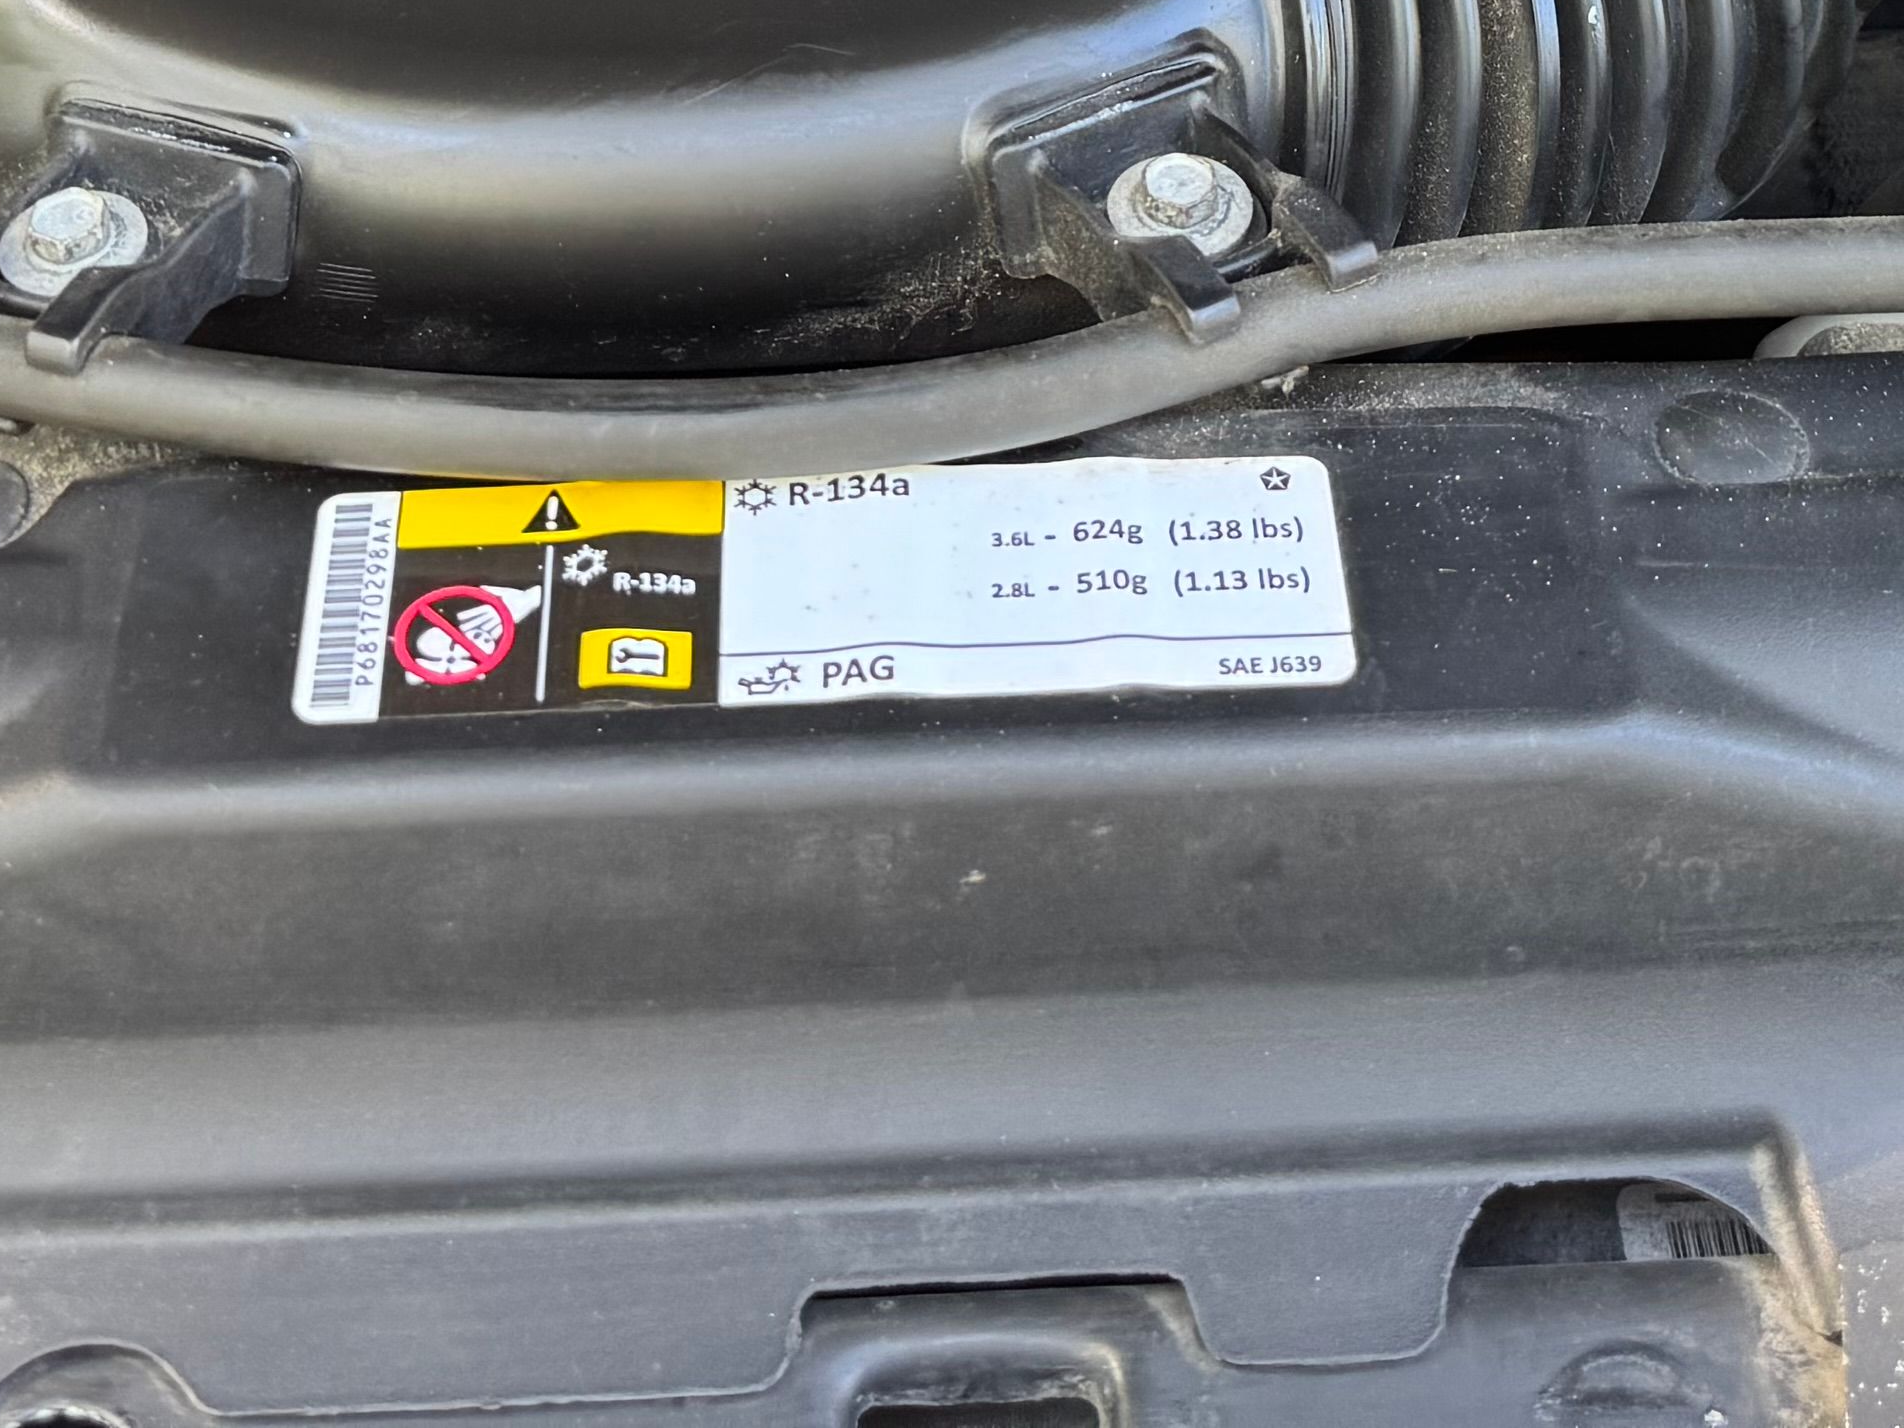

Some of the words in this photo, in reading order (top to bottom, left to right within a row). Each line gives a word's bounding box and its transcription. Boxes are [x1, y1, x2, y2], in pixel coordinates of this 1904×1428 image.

[788, 472, 910, 506] R-134a
[991, 531, 1036, 547] 3.6L
[1072, 518, 1144, 545] 624g
[1167, 519, 1243, 546] (1.38
[1251, 516, 1304, 544] lbs)
[612, 571, 697, 596] R-134a
[991, 583, 1036, 599] 2.8L
[1076, 568, 1148, 595] 510g
[1174, 569, 1248, 598] (1.13
[1257, 566, 1311, 594] lbs)
[355, 517, 393, 687] P68170298AA
[822, 655, 895, 689] PAG
[1218, 657, 1264, 675] SAE
[1269, 655, 1322, 674] J639
